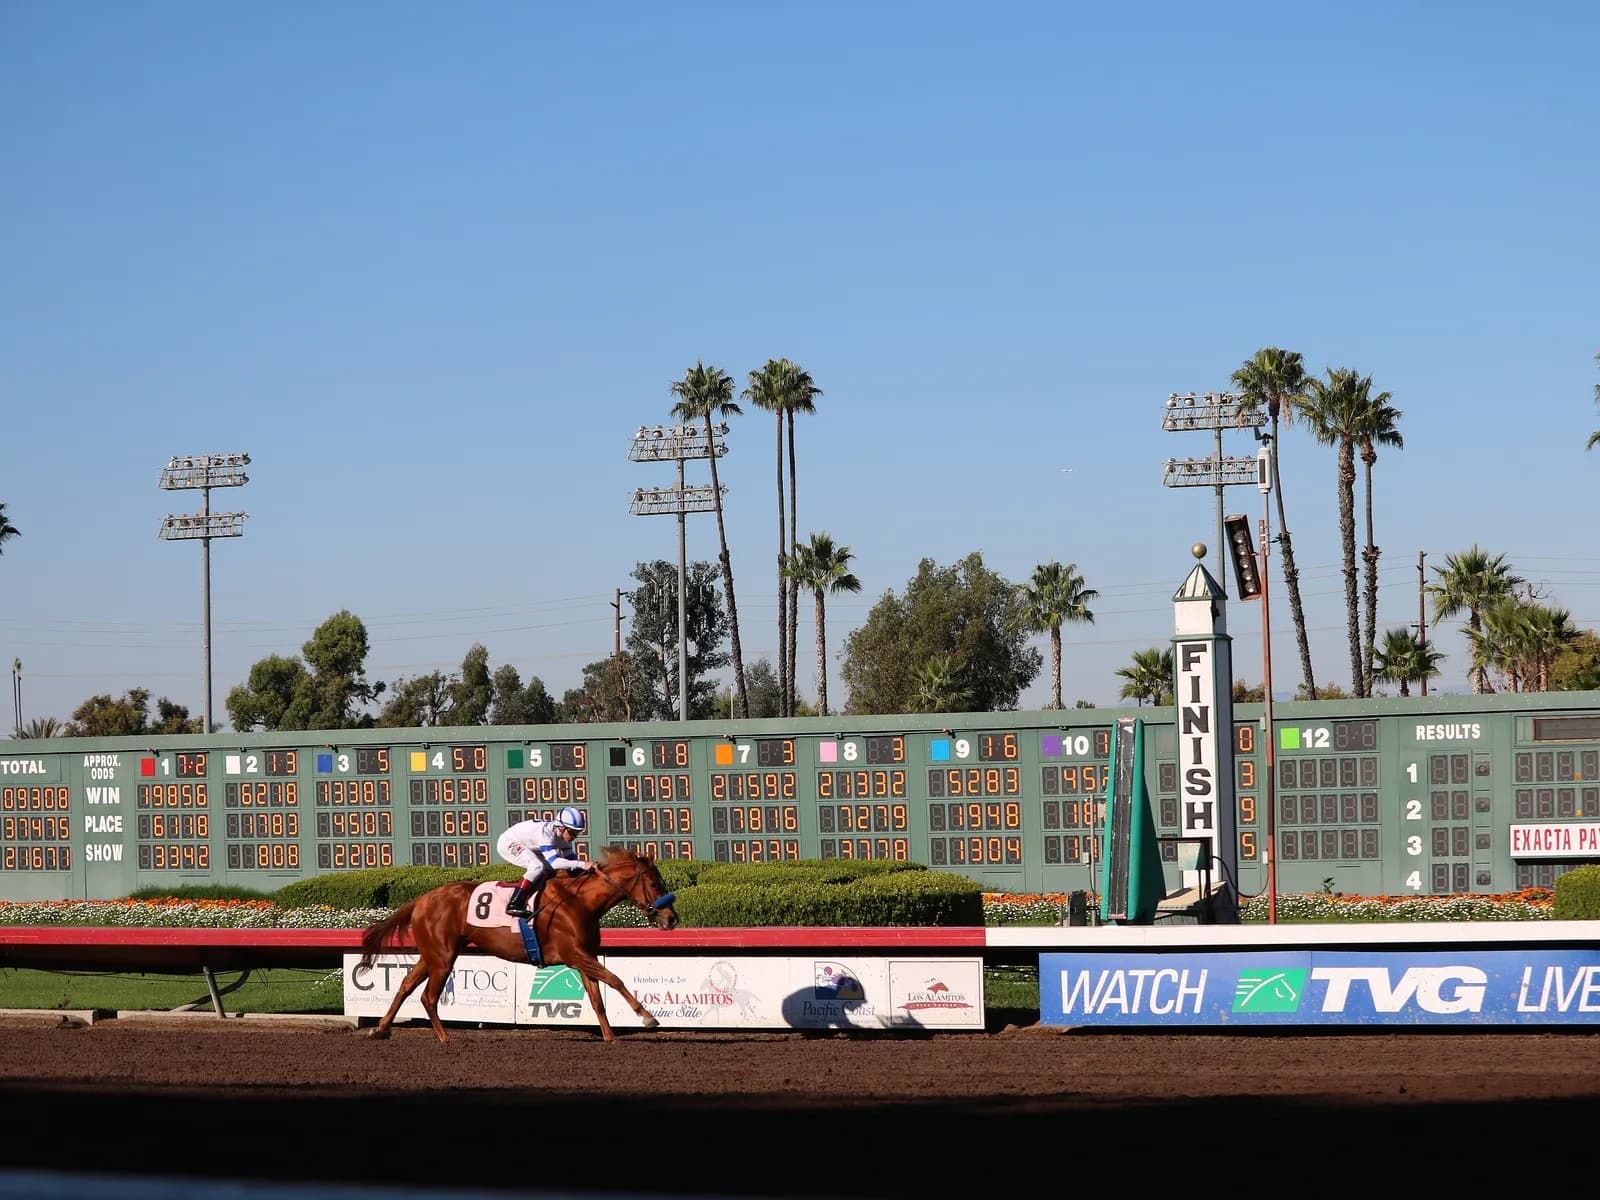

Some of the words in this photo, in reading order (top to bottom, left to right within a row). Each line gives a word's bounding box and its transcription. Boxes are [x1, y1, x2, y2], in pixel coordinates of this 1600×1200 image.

[1181, 643, 1213, 830] FINISH
[1302, 728, 1329, 748] 12
[1416, 724, 1480, 741] RESULTS
[738, 745, 750, 763] 7
[784, 741, 793, 762] 3
[844, 742, 857, 760] 8
[894, 738, 903, 760] 3
[956, 739, 970, 758] 9
[1063, 736, 1089, 755] 10
[1, 760, 46, 774] TOTAL
[84, 755, 120, 770] APPROX.
[162, 759, 169, 775] 1
[246, 756, 257, 772] 2
[338, 755, 349, 772] 3
[378, 750, 388, 771] 5
[432, 752, 444, 769] 4
[530, 749, 542, 767] 5
[574, 747, 583, 767] 9
[632, 748, 645, 766] 6
[91, 768, 114, 779] ODDS
[950, 770, 1017, 793] 5283
[1407, 763, 1417, 782] 1
[325, 782, 388, 803] 13387
[435, 780, 485, 801] 1630
[526, 779, 585, 800] 9009
[627, 777, 688, 798] 4797
[714, 774, 794, 797] 21592
[821, 772, 903, 795] 21332
[86, 787, 120, 804] WIN
[146, 785, 206, 805] 19856
[242, 784, 296, 804] 6218
[636, 809, 689, 830] 1773
[735, 808, 796, 830] 7816
[841, 806, 905, 828] 7279
[960, 804, 1018, 827] 1948
[1407, 800, 1421, 819] 2
[85, 816, 122, 832] PLACE
[154, 816, 207, 836] 6118
[250, 814, 297, 834] 1783
[335, 813, 390, 834] 4507
[445, 812, 486, 833] 626
[1407, 836, 1422, 855] 3
[1514, 829, 1570, 850] EXACTA
[86, 844, 123, 861] SHOW
[157, 846, 208, 866] 3342
[259, 846, 297, 865] 808
[336, 845, 391, 865] 2206
[446, 844, 488, 865] 413
[961, 839, 1019, 861] 1304
[1404, 871, 1422, 890] 4
[476, 892, 493, 919] 8
[458, 969, 508, 991] TOC
[1060, 969, 1209, 1015] WATCH
[1311, 966, 1488, 1014] TVG
[527, 1002, 583, 1018] TVG
[803, 1001, 839, 1017] Pacific
